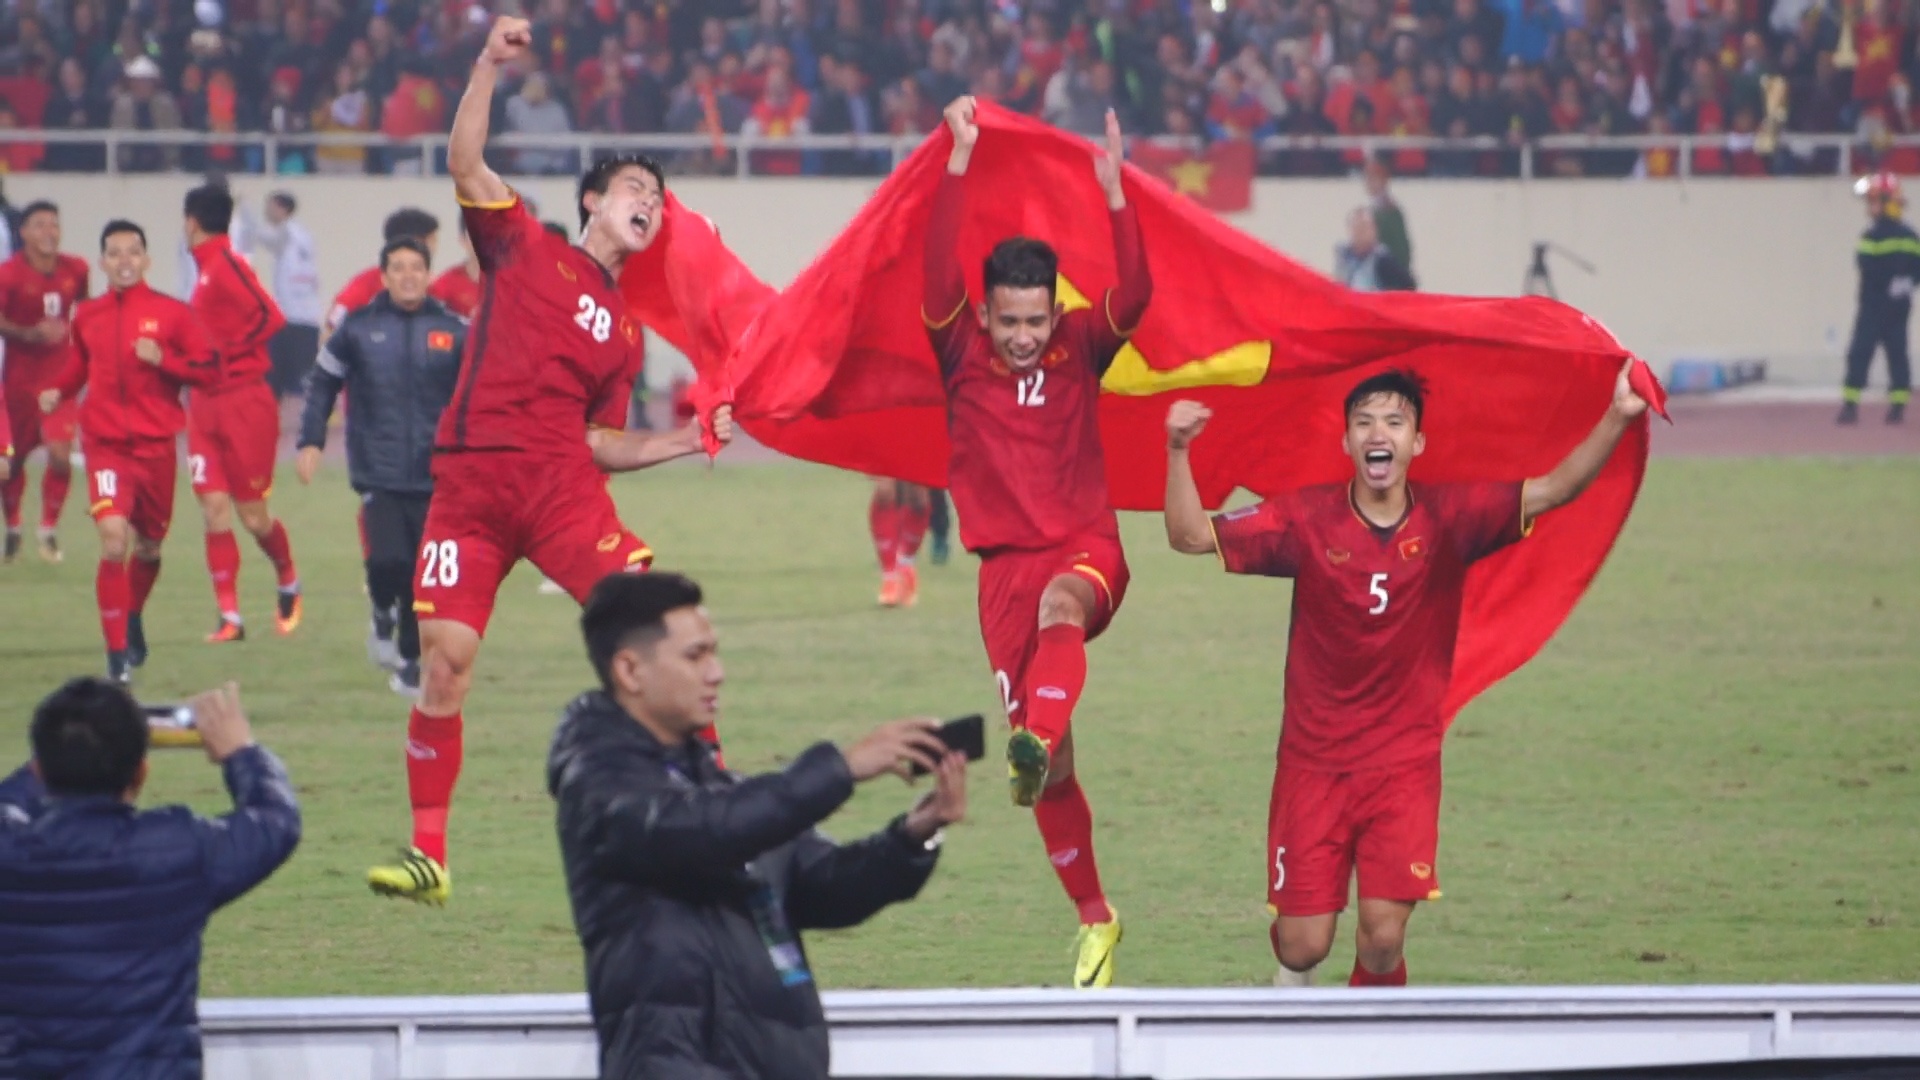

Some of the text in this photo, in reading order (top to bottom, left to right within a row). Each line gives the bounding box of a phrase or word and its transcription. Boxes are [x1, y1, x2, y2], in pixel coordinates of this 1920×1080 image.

[574, 294, 612, 342] 28
[1017, 368, 1045, 407] 12
[95, 468, 117, 497] 10
[421, 539, 459, 588] 28
[1369, 573, 1388, 615] 5
[1274, 846, 1285, 891] 5
